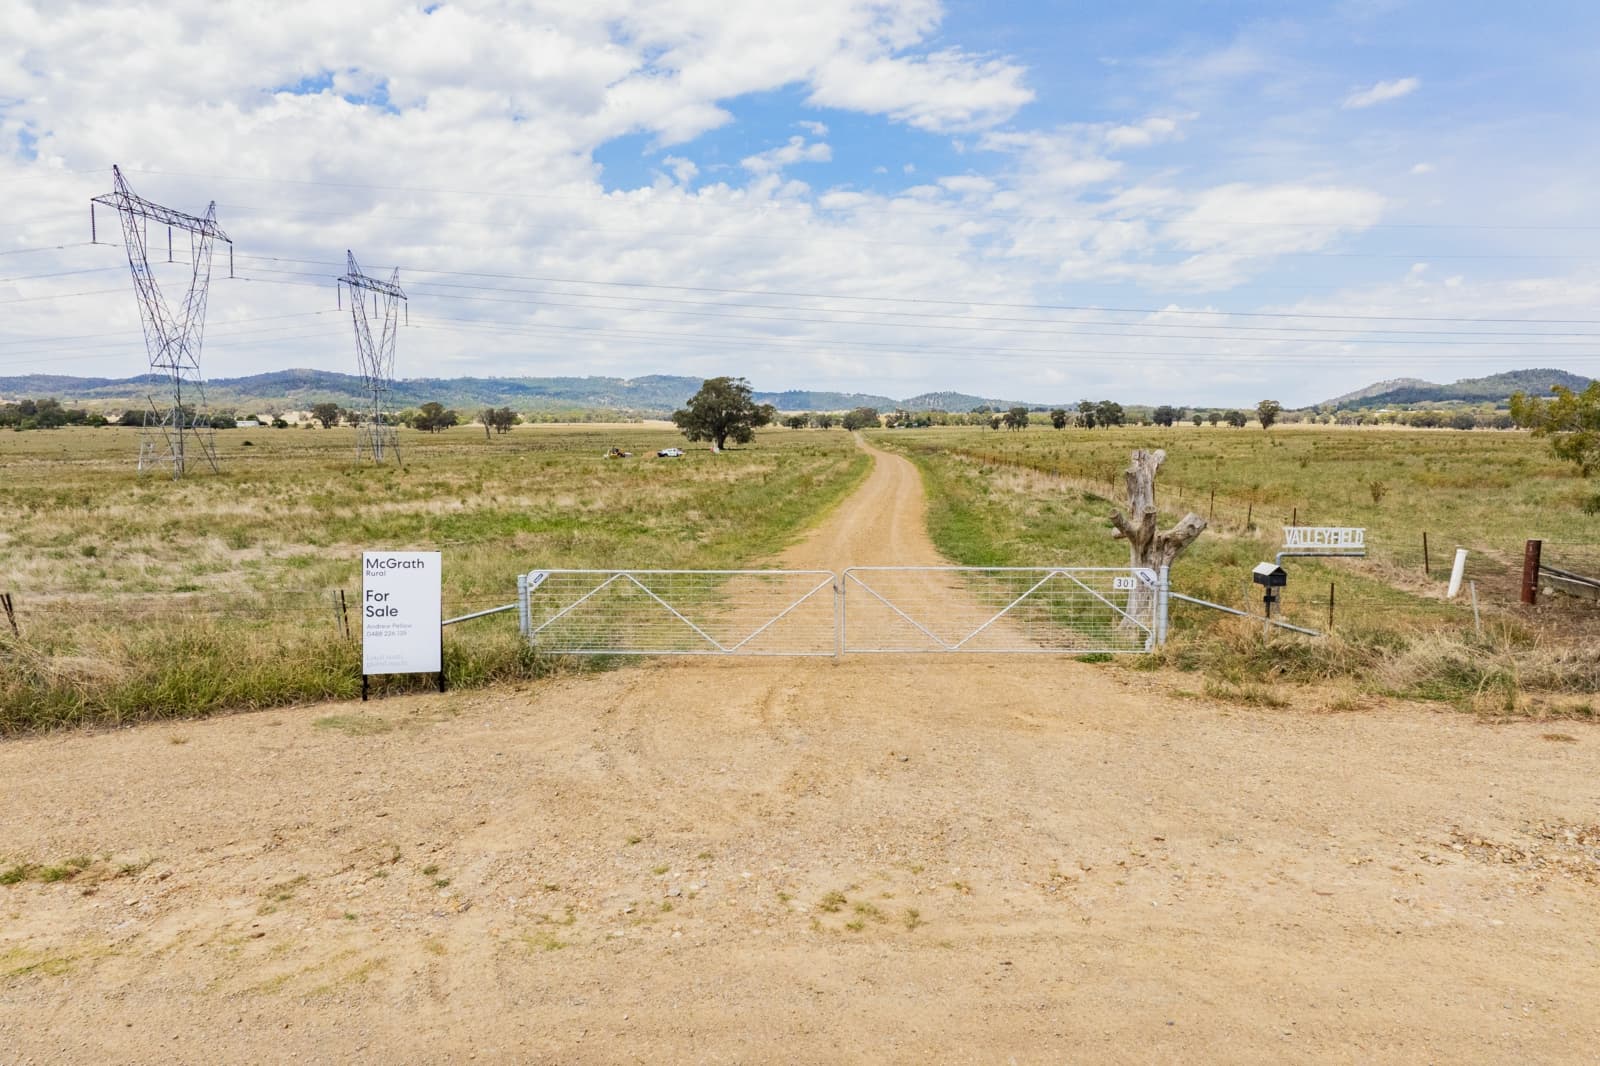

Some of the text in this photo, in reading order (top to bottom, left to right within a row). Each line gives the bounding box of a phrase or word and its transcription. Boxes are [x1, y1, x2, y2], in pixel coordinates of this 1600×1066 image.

[1284, 527, 1364, 546] VALLEYFIELD
[366, 558, 425, 569] McGrath
[1117, 579, 1134, 588] 301
[366, 590, 390, 602] For
[366, 605, 399, 618] Sale
